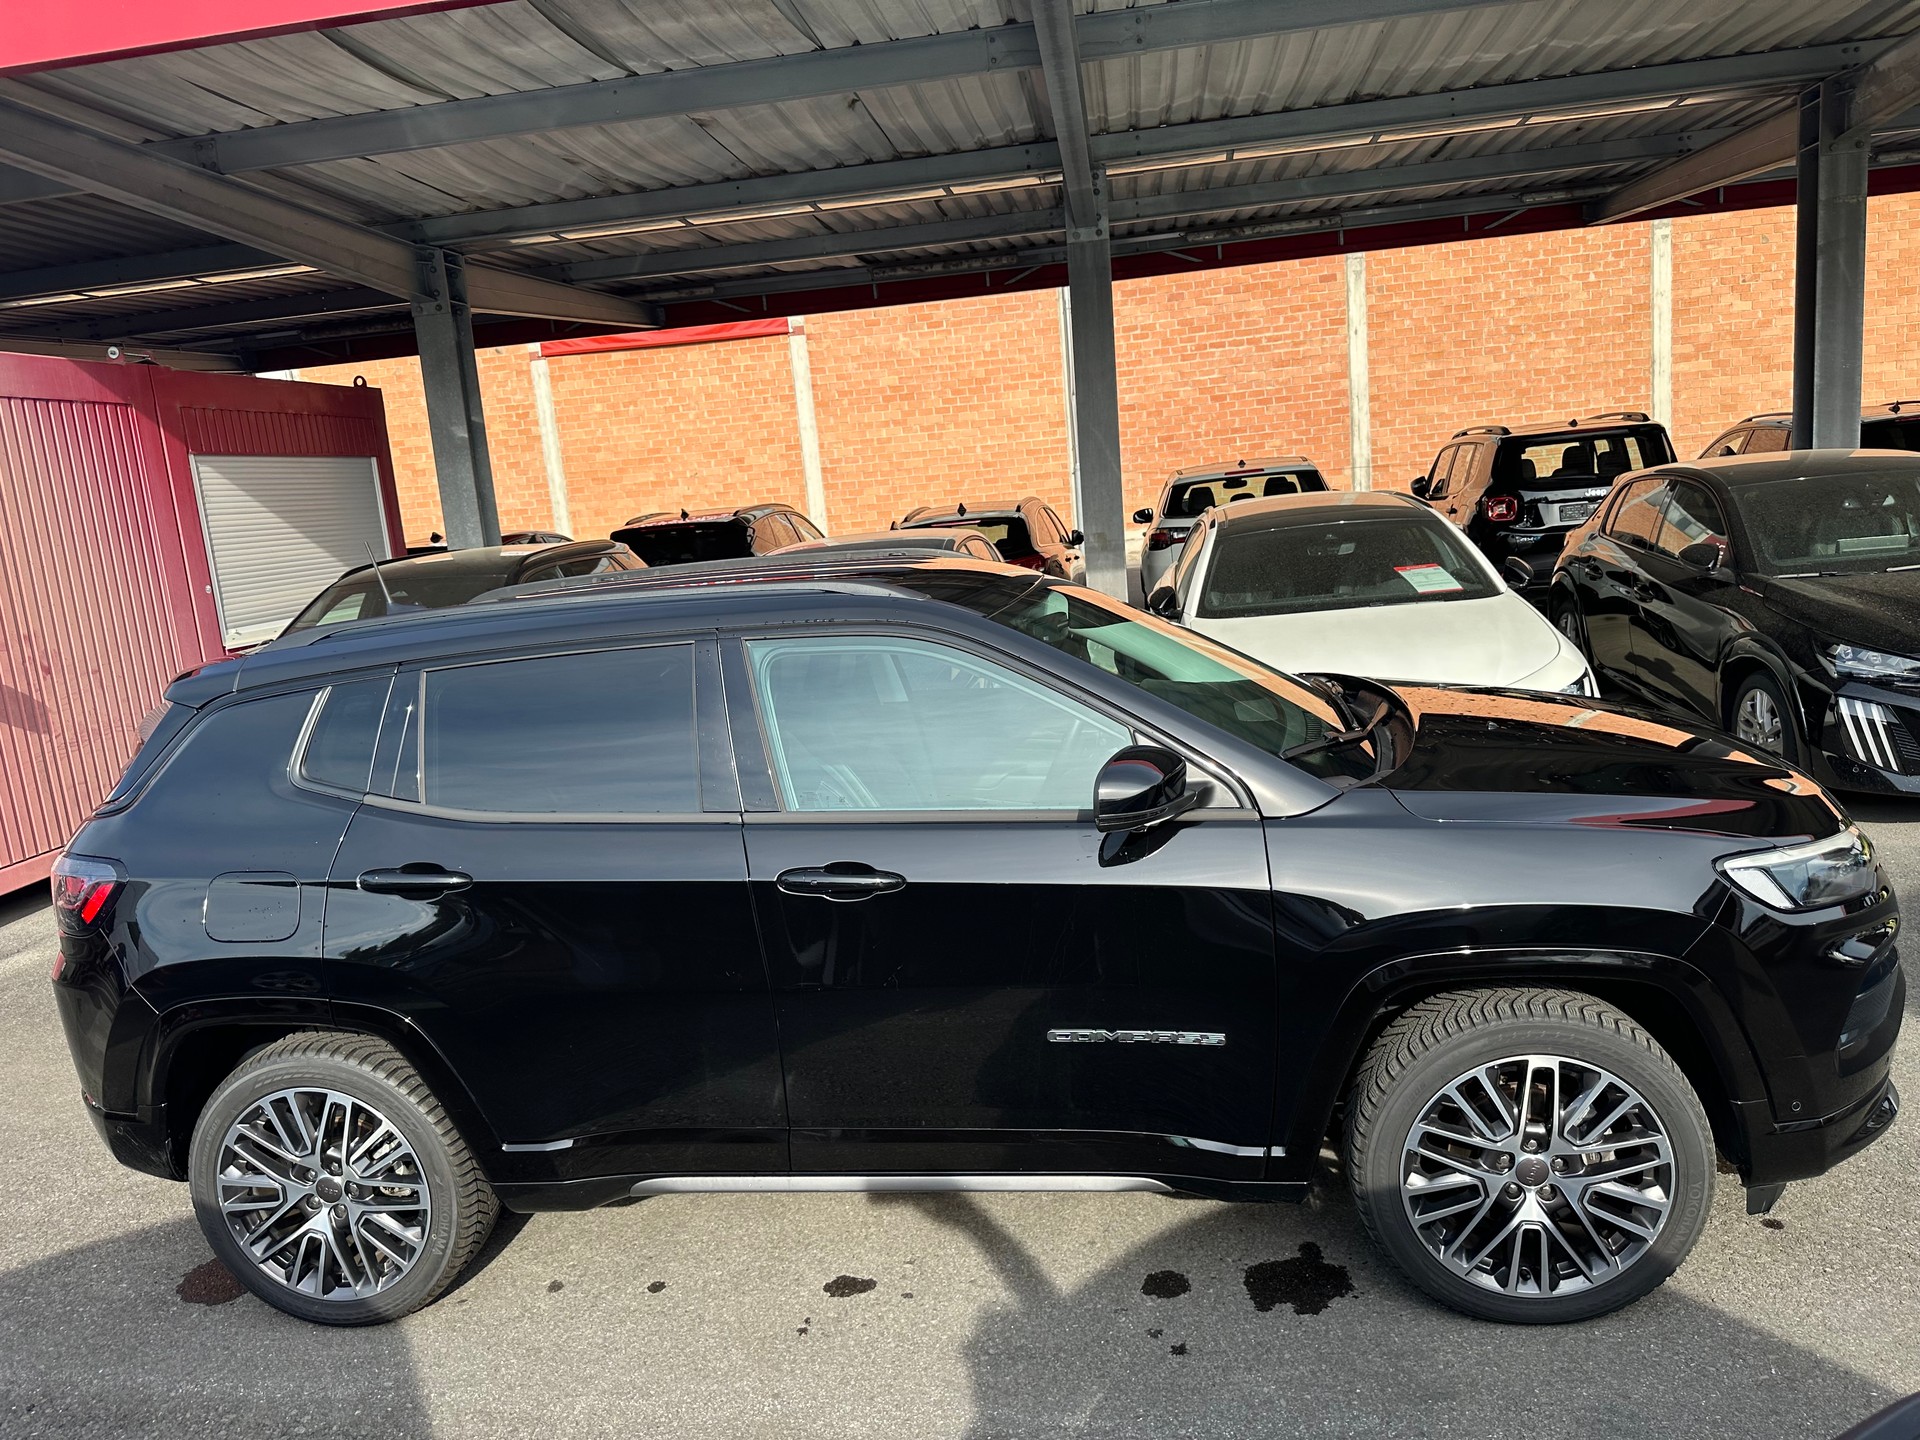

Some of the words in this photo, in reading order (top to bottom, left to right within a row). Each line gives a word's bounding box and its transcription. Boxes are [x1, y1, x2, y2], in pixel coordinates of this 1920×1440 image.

[1584, 488, 1607, 497] Jeep
[1046, 1028, 1227, 1046] COMPASS
[432, 1190, 451, 1256] YOKOHAMA
[1662, 1181, 1703, 1254] YOKOHAMA
